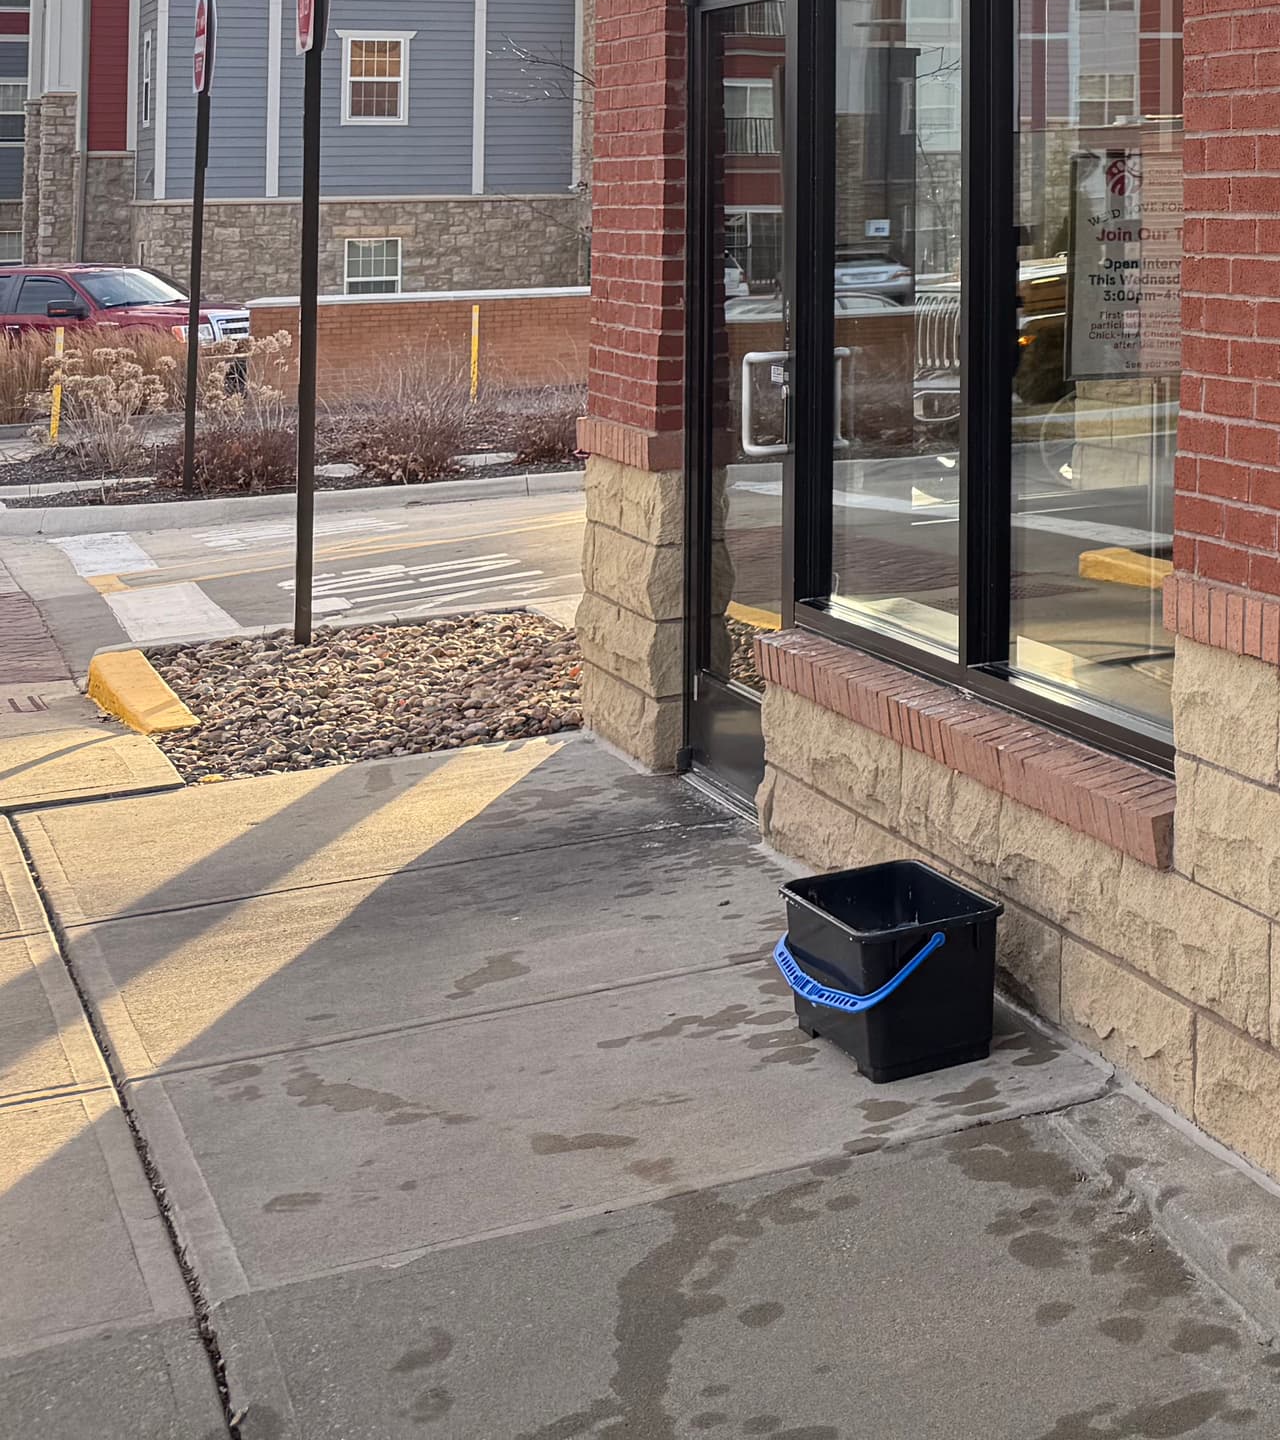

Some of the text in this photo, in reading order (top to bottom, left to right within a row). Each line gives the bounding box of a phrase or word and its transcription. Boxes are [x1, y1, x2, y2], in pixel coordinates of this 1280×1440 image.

[1096, 227, 1132, 242] Join
[1138, 227, 1168, 241] Our
[1104, 258, 1138, 272] Open
[1088, 274, 1116, 286] This
[1113, 340, 1137, 349] after
[1125, 361, 1142, 369] See
